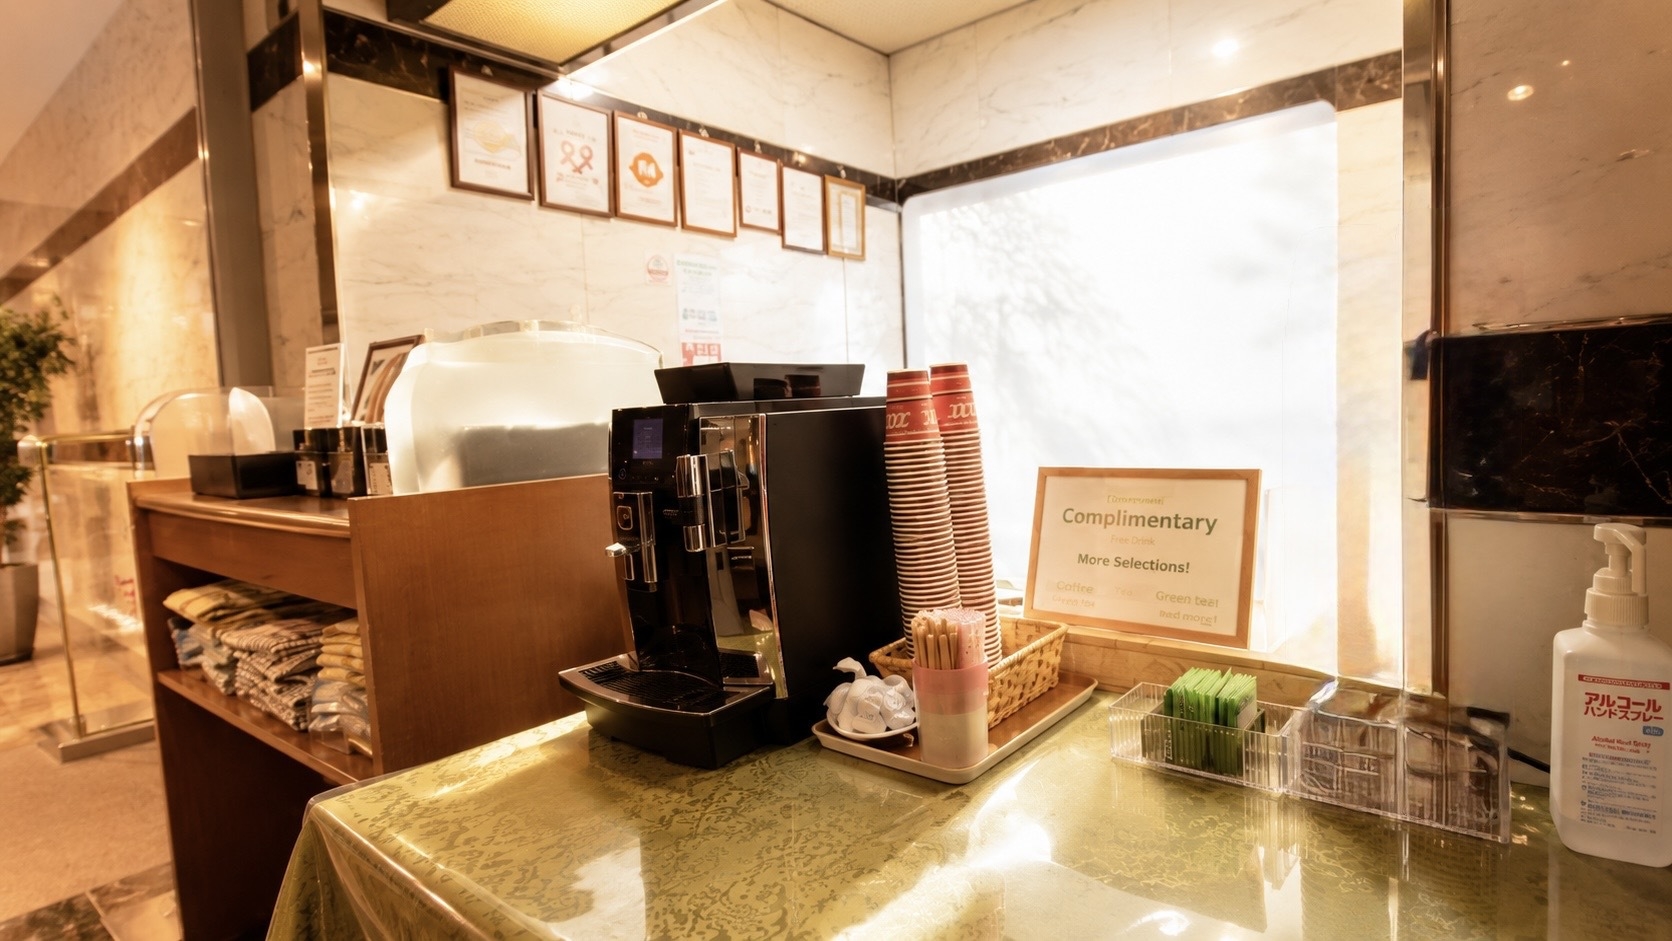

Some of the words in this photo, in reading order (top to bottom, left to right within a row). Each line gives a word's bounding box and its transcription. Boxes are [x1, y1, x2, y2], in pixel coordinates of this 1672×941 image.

[1062, 508, 1218, 536] Complimentary
[1077, 553, 1110, 567] More
[1114, 556, 1190, 574] Selections!
[1155, 590, 1192, 604] Green
[1584, 692, 1662, 713] アルコール
[1583, 706, 1664, 722] ハンドスプレー
